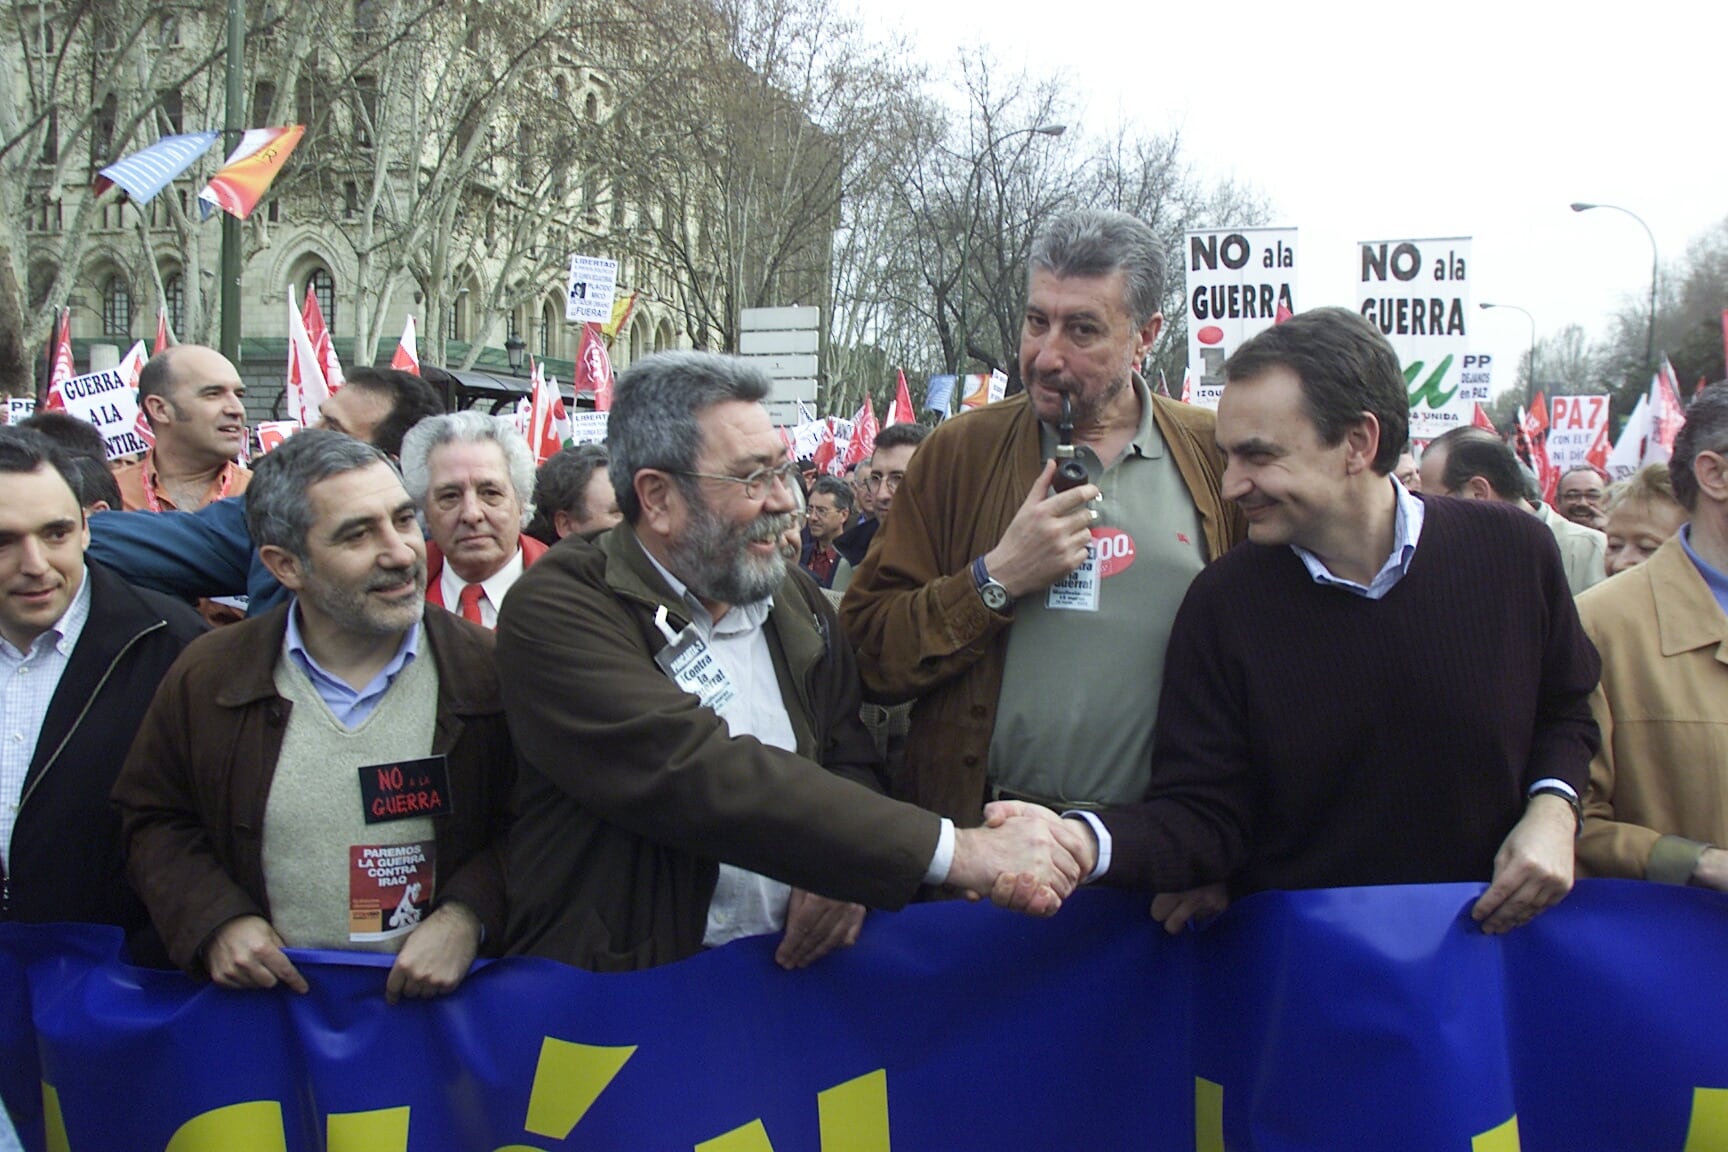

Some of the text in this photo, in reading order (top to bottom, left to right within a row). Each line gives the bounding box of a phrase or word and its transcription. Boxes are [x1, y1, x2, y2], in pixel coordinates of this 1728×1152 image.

[1191, 233, 1293, 272] NO a la
[1361, 242, 1466, 282] NO a la
[1192, 283, 1294, 320] GUERRA
[1361, 297, 1465, 336] GUERRA
[1463, 355, 1491, 369] PP
[64, 370, 125, 400] GUERRA
[89, 403, 123, 426] A LA
[575, 413, 607, 421] LIBERT
[1423, 412, 1459, 420] UNIDA
[106, 432, 149, 458] NTIRA
[697, 673, 709, 685] la
[376, 766, 404, 792] NO
[371, 789, 442, 817] GUERRA
[358, 854, 426, 868] LA GUERRA
[363, 845, 422, 858] PAREMOS
[367, 865, 417, 878] CONTRA
[378, 875, 407, 887] IRAQ
